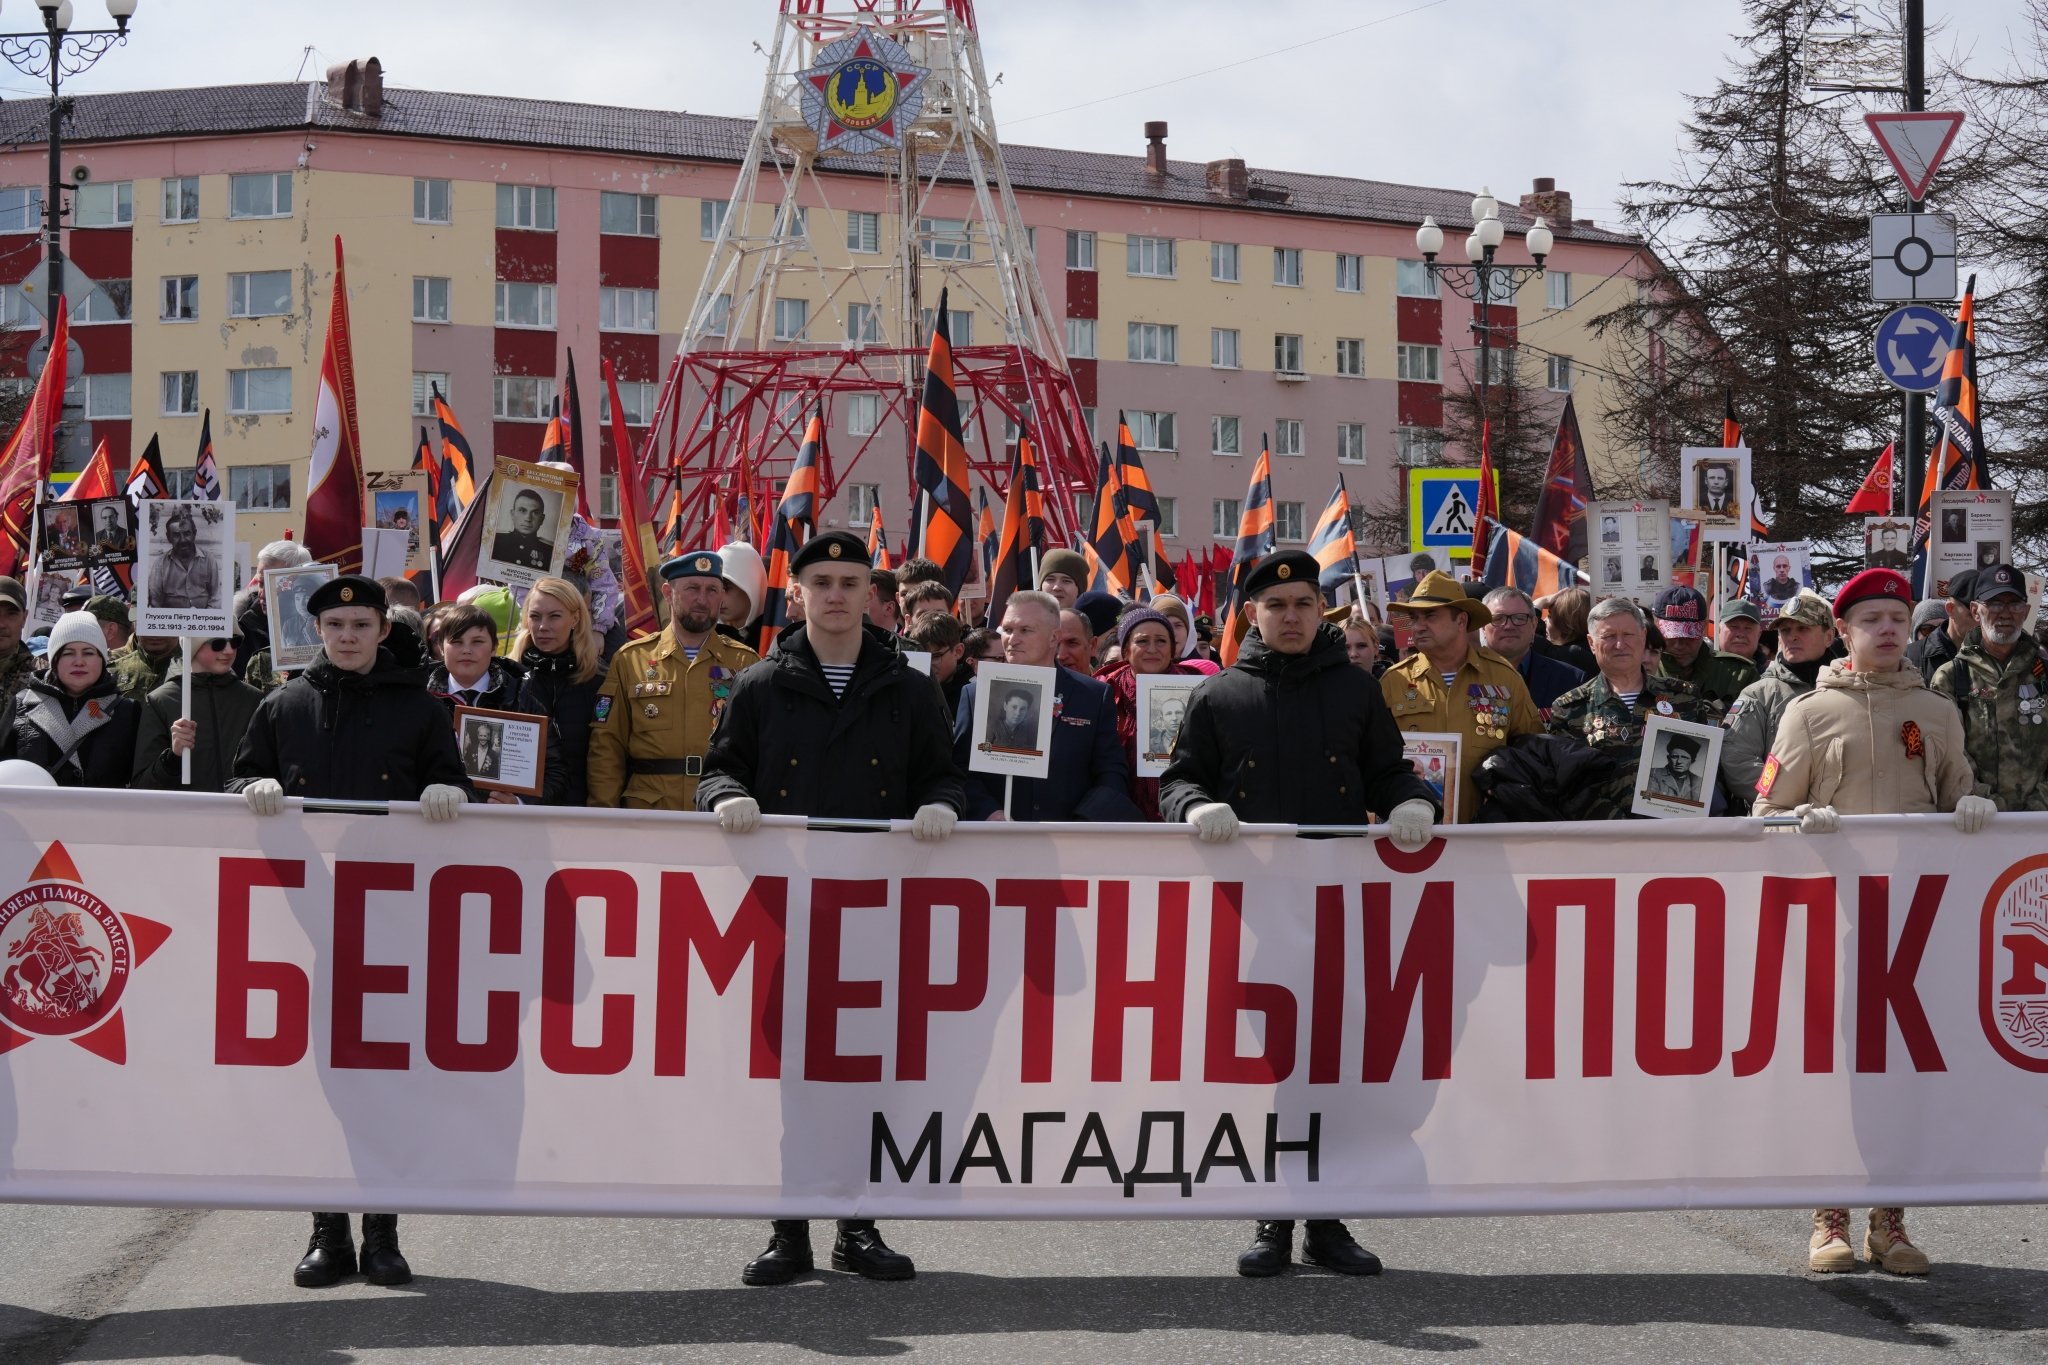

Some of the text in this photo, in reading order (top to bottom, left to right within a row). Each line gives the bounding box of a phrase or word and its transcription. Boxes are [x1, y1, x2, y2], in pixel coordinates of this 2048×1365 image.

[846, 64, 879, 72] СССР
[844, 117, 877, 127] ПОБЕДА
[145, 613, 172, 621] Глухота
[173, 613, 191, 621] Пётр
[42, 887, 102, 916] ПАМЯТЬ
[103, 916, 126, 973] ВМЕСТЕ
[215, 839, 1453, 1084] БЕССМЕРТНЫЙ
[1525, 875, 1947, 1079] ПОЛК
[870, 1112, 1320, 1196] МАГАДАН
